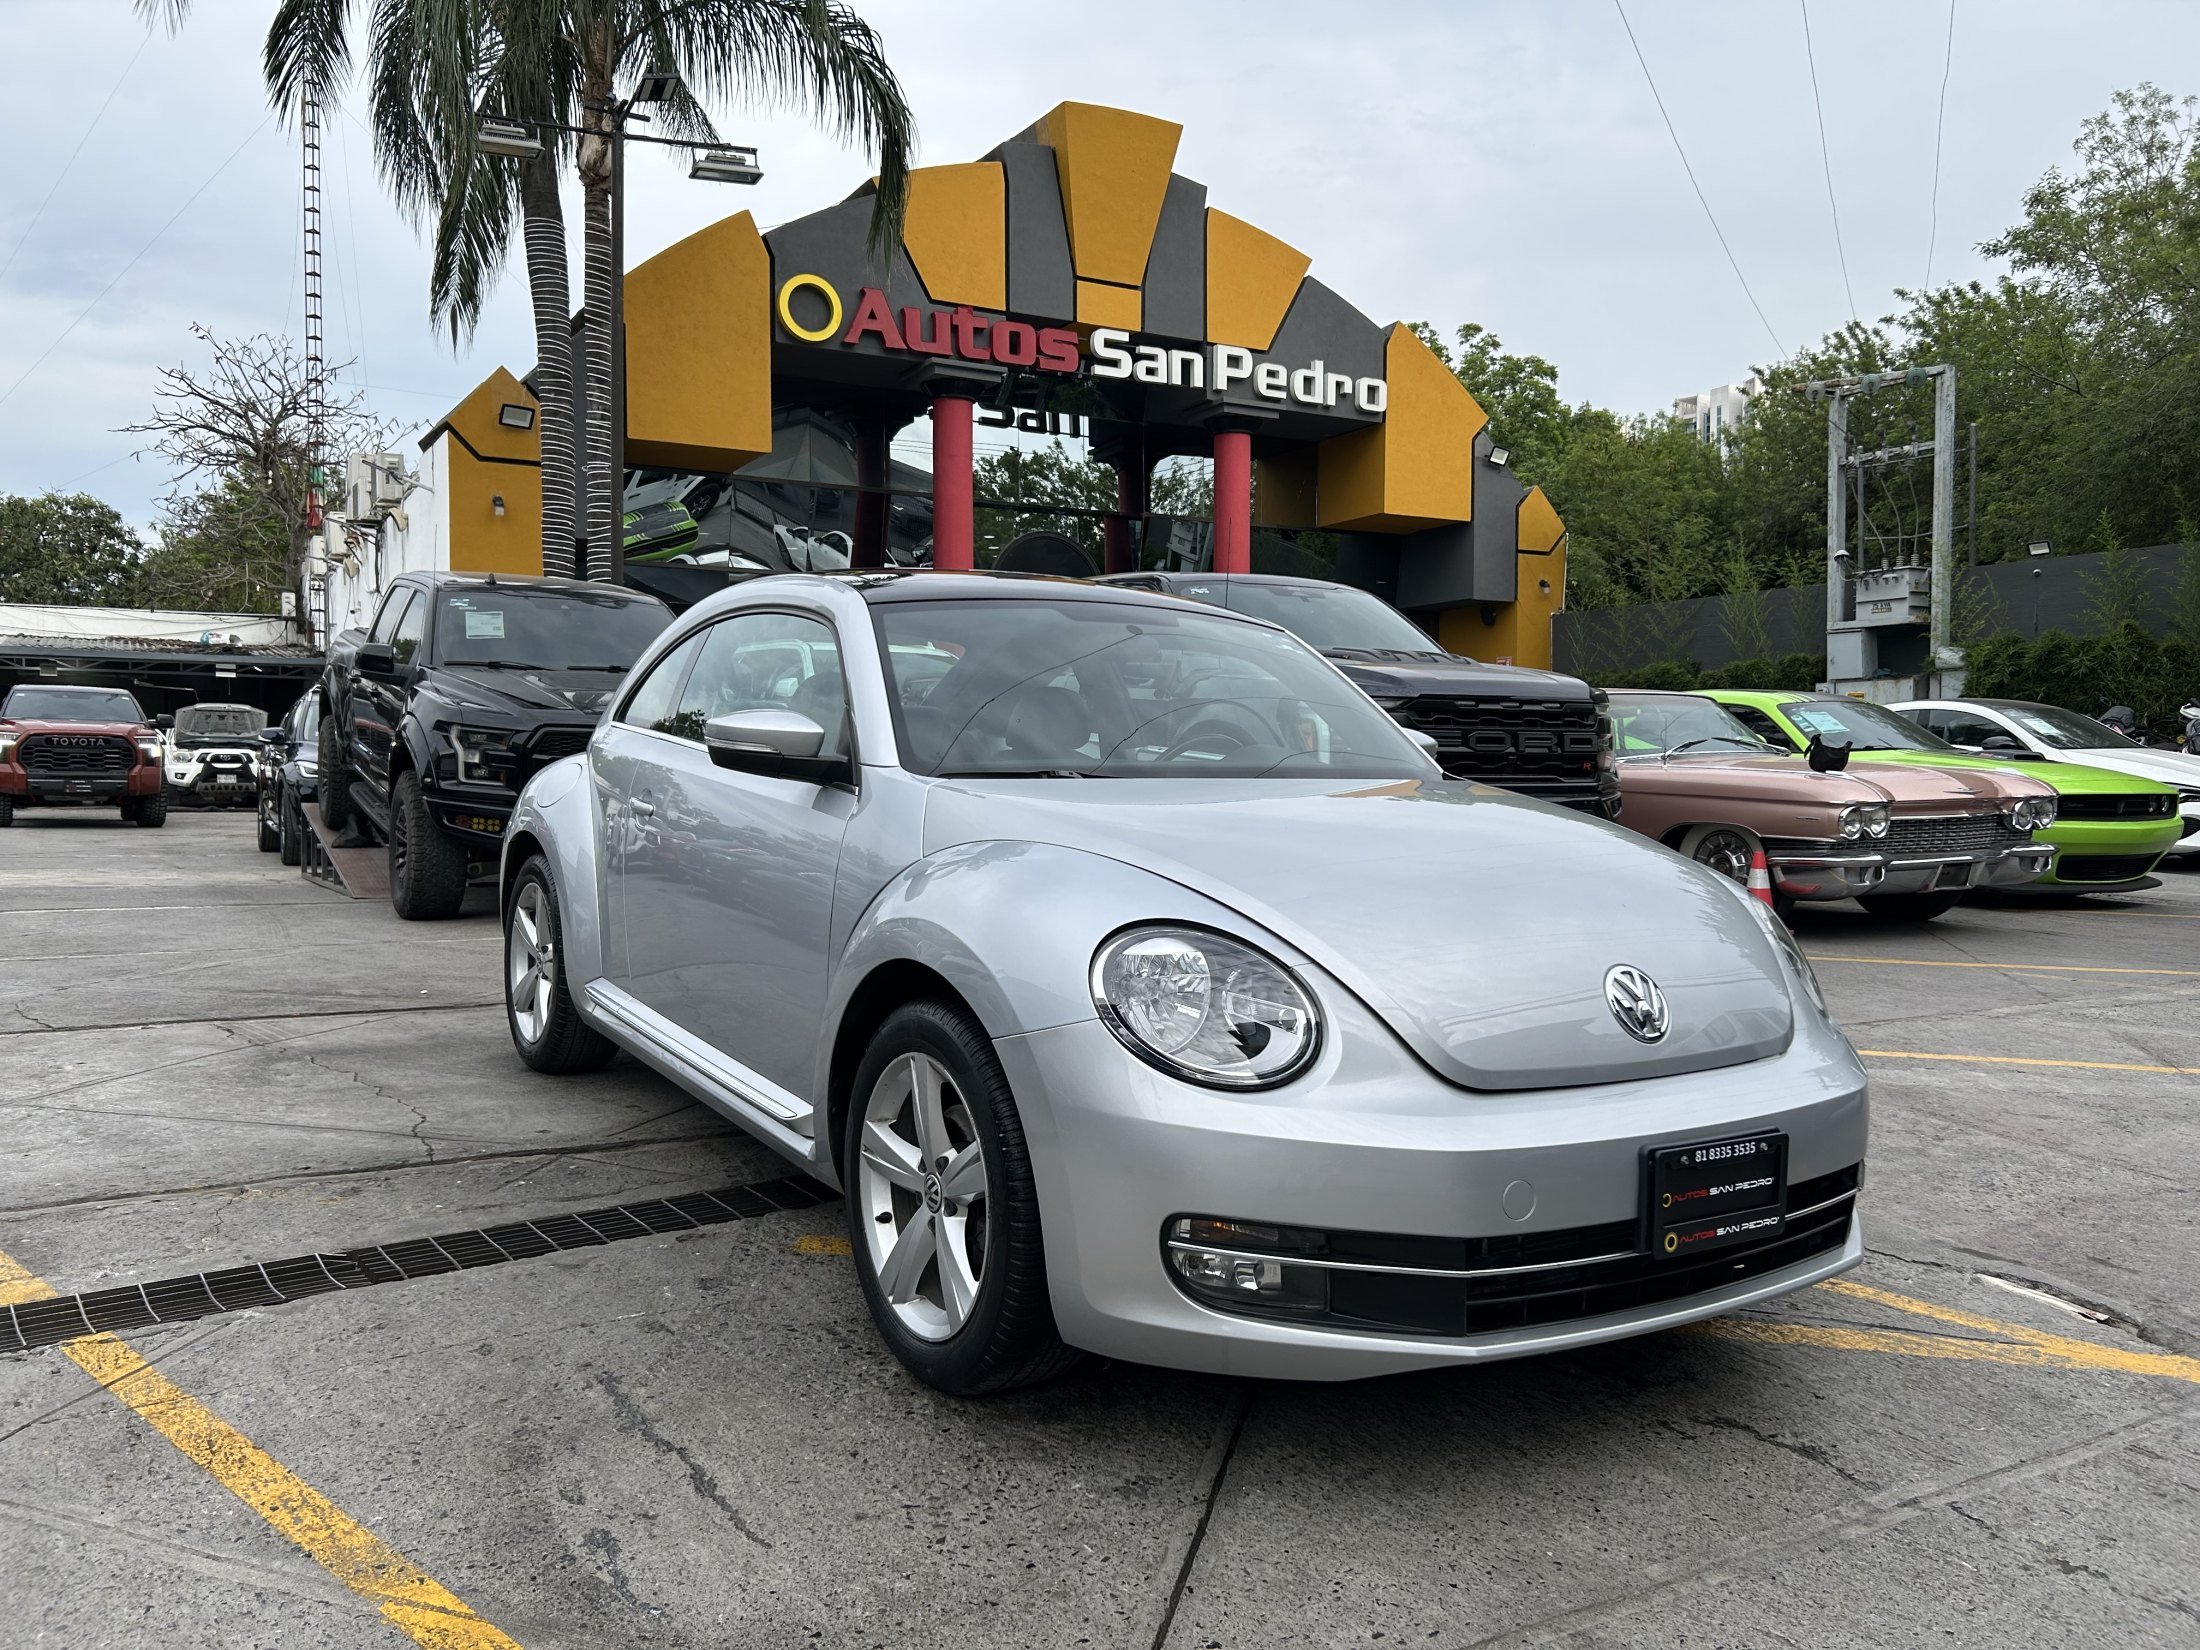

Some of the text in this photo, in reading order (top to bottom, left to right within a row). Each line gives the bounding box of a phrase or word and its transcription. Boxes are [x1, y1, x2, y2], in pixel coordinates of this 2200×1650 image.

[843, 287, 1388, 413] Autos San Pedro
[51, 737, 105, 746] TOYOTA
[1695, 1142, 1756, 1162] 81 8335 3535
[1672, 1177, 1773, 1203] AUTOS SAN PEDRO
[1679, 1217, 1778, 1243] AUTOS SAN PEDRO
